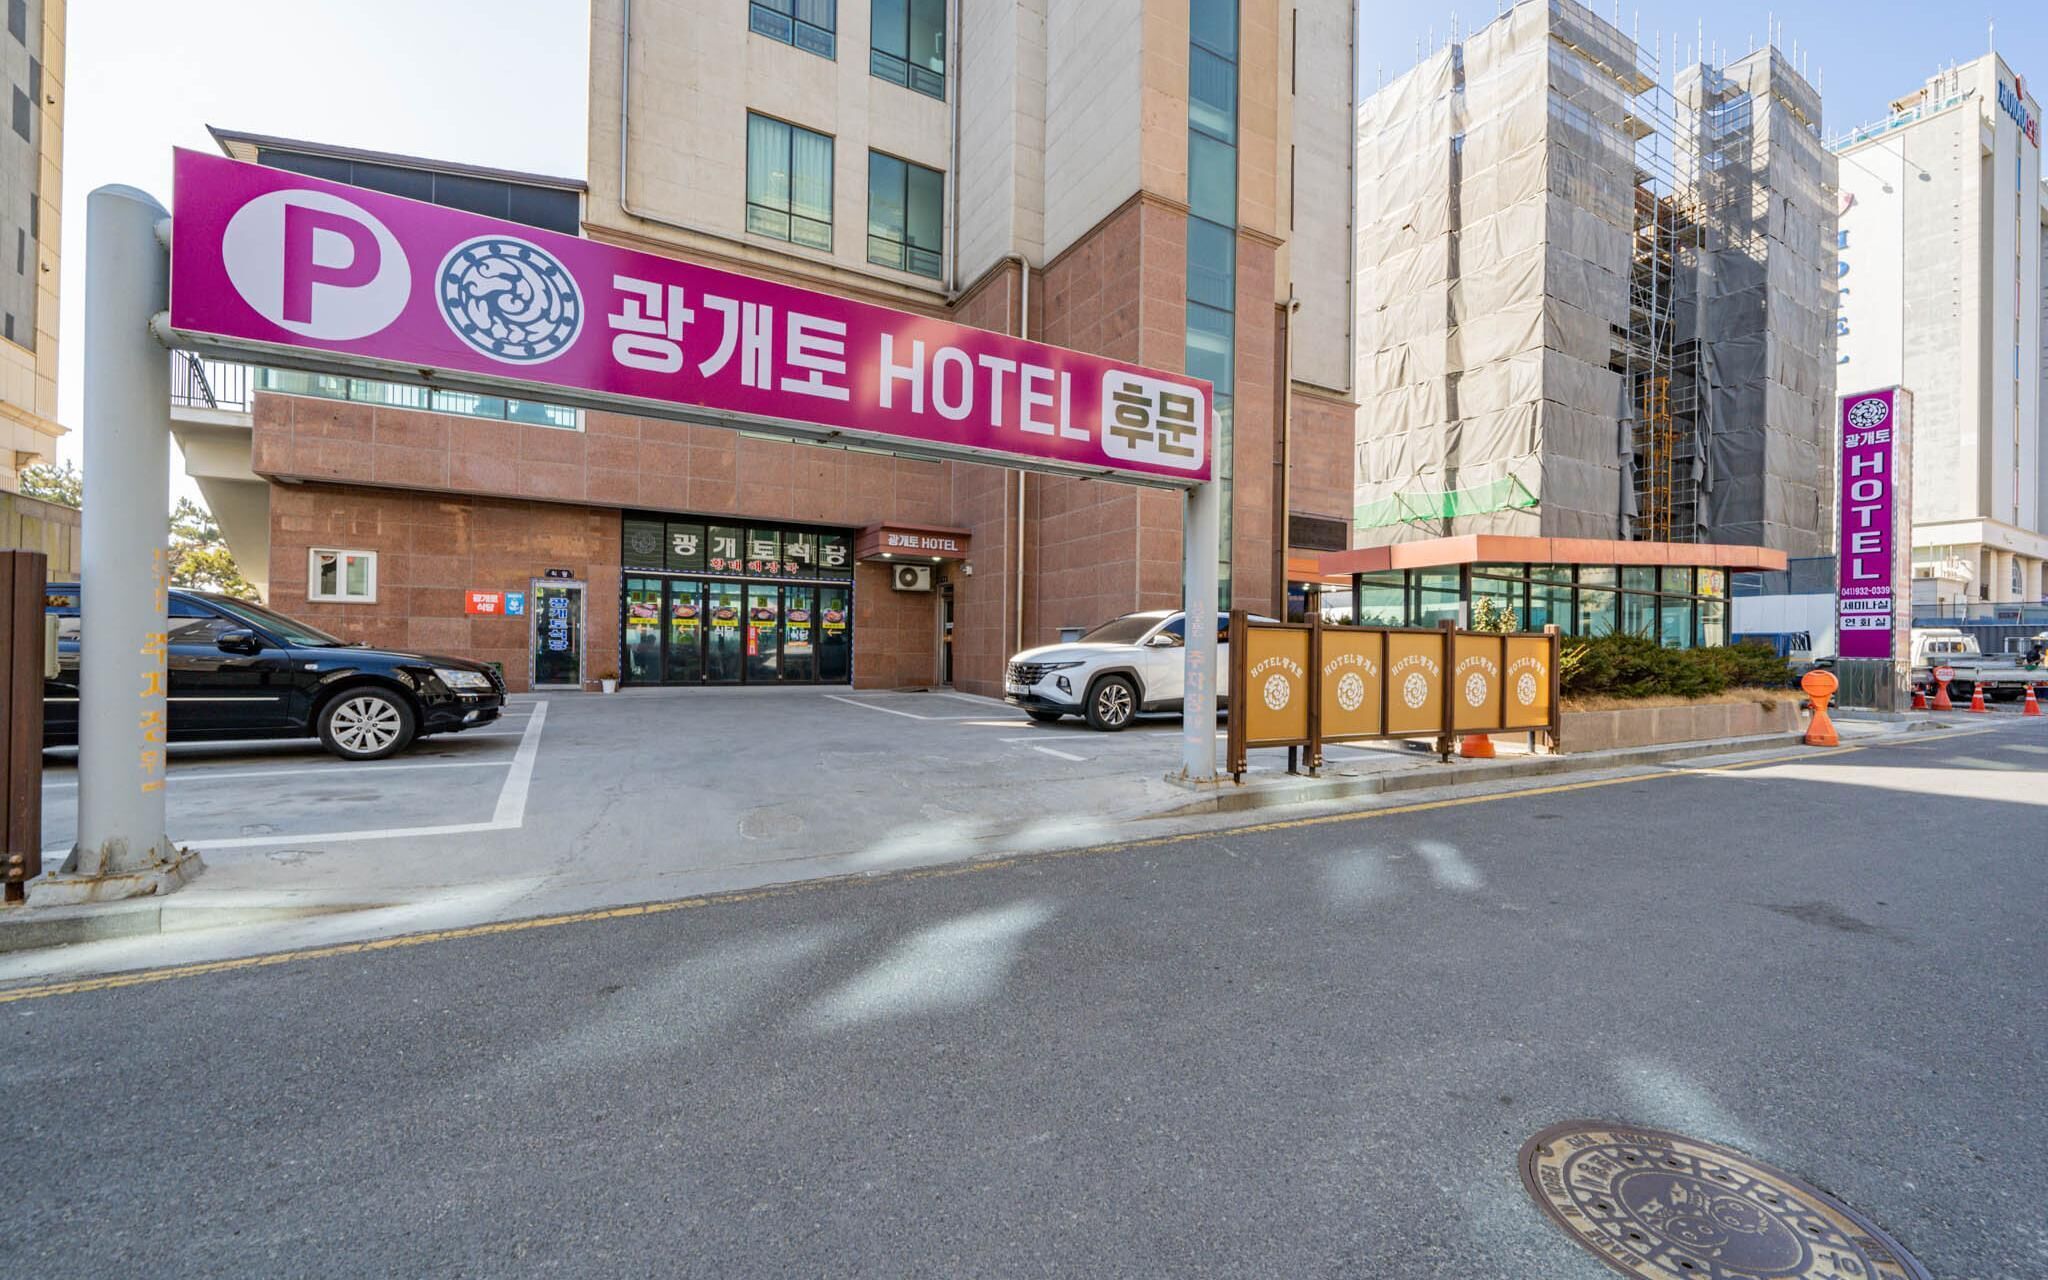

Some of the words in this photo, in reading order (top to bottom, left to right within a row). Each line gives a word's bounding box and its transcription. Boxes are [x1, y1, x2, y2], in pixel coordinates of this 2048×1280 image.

[282, 203, 382, 325] P
[608, 273, 850, 401] 광개토
[879, 332, 1090, 442] HOTEL
[1111, 381, 1197, 458] 후문
[1845, 428, 1890, 448] 광개토
[887, 533, 920, 548] 광개토
[921, 537, 959, 551] HOTEL
[1851, 451, 1884, 580] HOTEL
